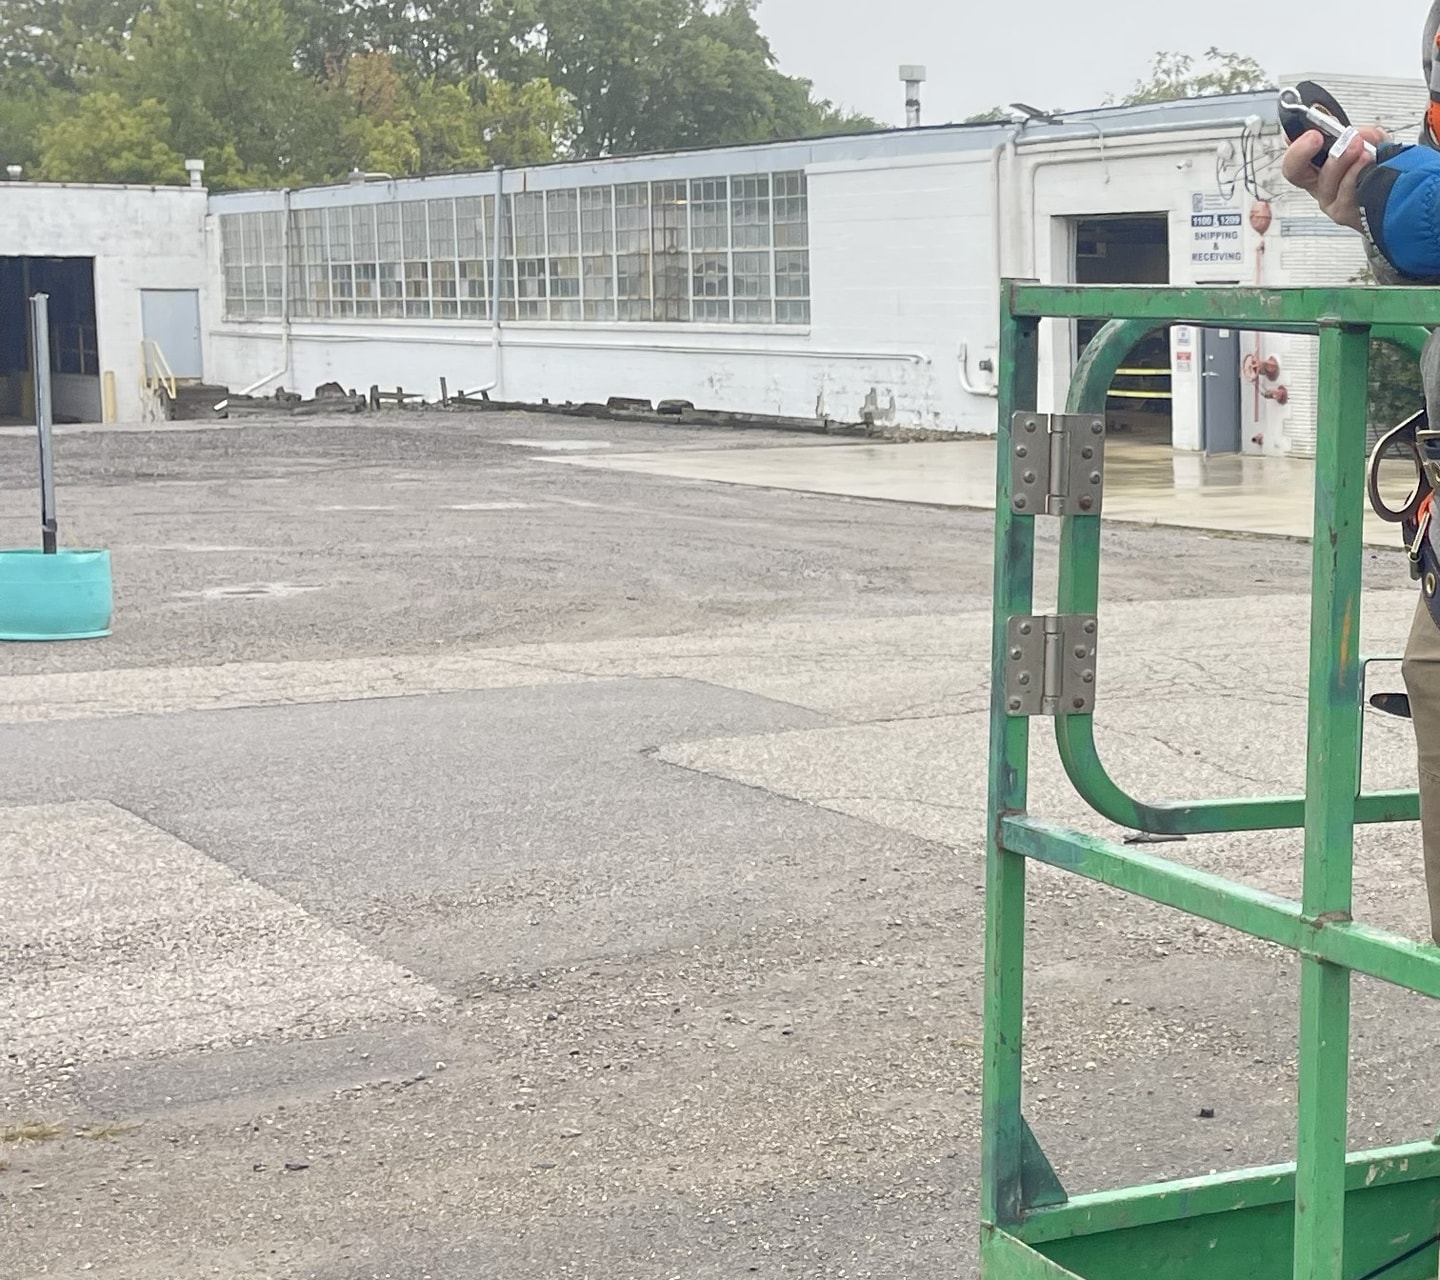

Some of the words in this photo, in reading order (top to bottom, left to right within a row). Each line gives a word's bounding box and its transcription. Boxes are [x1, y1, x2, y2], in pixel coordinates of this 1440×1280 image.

[1194, 231, 1238, 241] SHIPPING
[1212, 242, 1219, 251] &
[1191, 252, 1241, 261] RECEIVING
